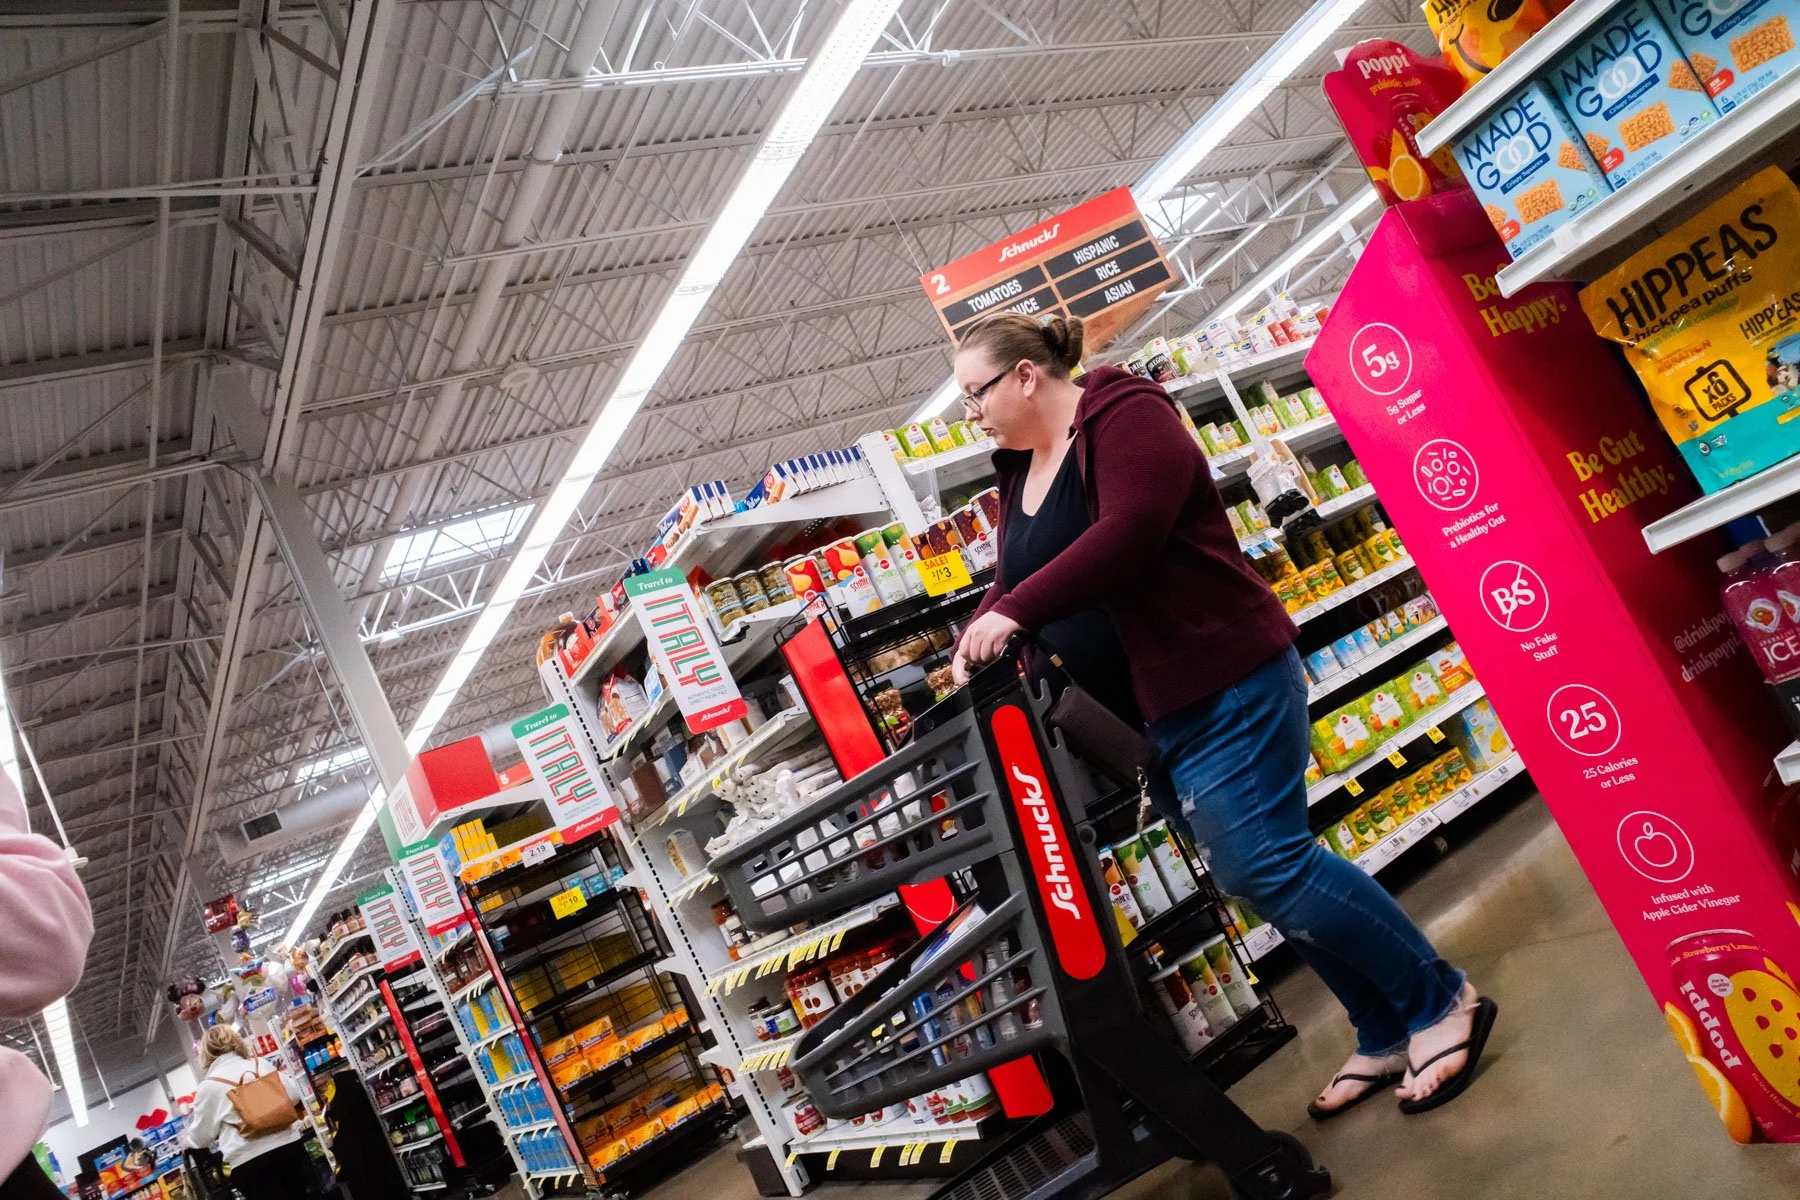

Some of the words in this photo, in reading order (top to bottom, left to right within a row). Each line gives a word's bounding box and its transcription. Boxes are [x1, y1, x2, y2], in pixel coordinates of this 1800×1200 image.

[1357, 47, 1410, 79] poppi
[1560, 8, 1650, 96] MADE
[1575, 39, 1662, 117] GOOD
[1462, 92, 1541, 170] MADE
[1476, 121, 1552, 190] GOOD
[999, 223, 1061, 263] Schnucks
[1073, 235, 1120, 266] HISPANIC
[930, 274, 951, 296] 2
[1094, 260, 1121, 281] RICE
[1606, 204, 1778, 337] HIPPEAS
[967, 279, 1023, 313] TOMATOES
[1103, 279, 1136, 304] ASIAN
[1462, 274, 1500, 301] Be
[1005, 297, 1040, 315] AUCE
[1479, 295, 1567, 337] Happy.
[1627, 295, 1701, 348] chickpea
[1702, 271, 1753, 306] puffs
[1362, 344, 1400, 378] 5g
[1387, 402, 1400, 416] 5g
[1398, 389, 1423, 411] Sugar
[1702, 371, 1729, 405] x6
[1711, 393, 1738, 412] PACKS
[1397, 414, 1407, 425] or
[1406, 402, 1427, 422] Less
[1566, 451, 1604, 482] Be
[1599, 430, 1645, 465] Gut
[1578, 464, 1675, 524] Healthy.
[1442, 510, 1486, 537] Prebiotics
[1484, 502, 1499, 514] for
[1449, 541, 1457, 549] a
[1454, 524, 1489, 545] Healthy
[1488, 514, 1507, 528] Gut
[924, 555, 948, 570] SALE!
[637, 578, 665, 591] Travel
[664, 577, 673, 585] to
[1490, 577, 1536, 618] BS
[643, 593, 723, 687] ITALY
[1520, 640, 1535, 653] No
[1533, 631, 1558, 648] Fake
[1533, 645, 1559, 662] Stuff
[1763, 635, 1800, 665] ICE
[701, 705, 731, 723] Schnucks
[1560, 701, 1607, 740] 25
[500, 773, 510, 786] 5
[1583, 767, 1598, 780] 25
[1597, 756, 1639, 776] Calories
[1600, 777, 1612, 789] or
[1610, 771, 1636, 786] Less
[529, 844, 547, 858] 2.19
[1012, 762, 1081, 920] Schnucks
[1642, 906, 1669, 922] Apple
[1668, 903, 1699, 916] Cider
[1697, 893, 1742, 913] Vinegar
[1651, 889, 1690, 905] Infused
[1688, 884, 1715, 898] with
[1679, 980, 1742, 1069] poppi
